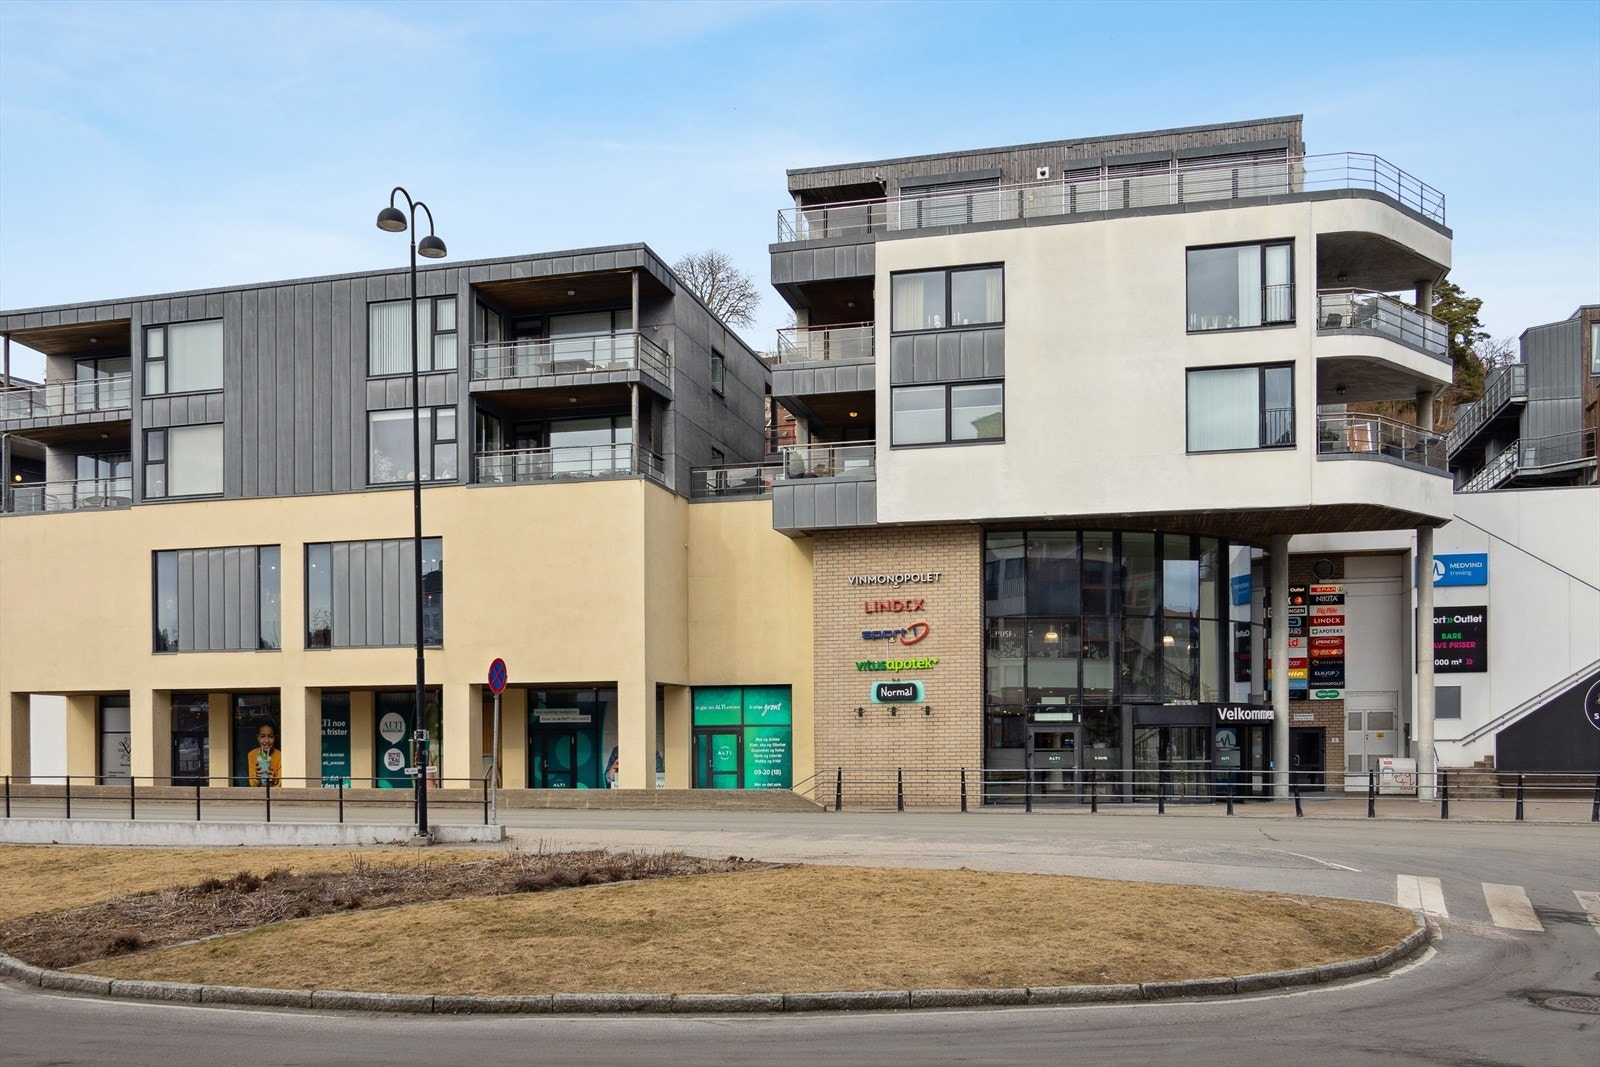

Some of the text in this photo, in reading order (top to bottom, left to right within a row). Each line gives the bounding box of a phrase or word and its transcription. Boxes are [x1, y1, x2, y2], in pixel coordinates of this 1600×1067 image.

[848, 572, 941, 585] VINMONOPOLET
[864, 600, 924, 613] LINDEX
[1454, 615, 1482, 623] Outlet
[862, 628, 907, 640] sport
[856, 658, 933, 672] vitusapotek
[880, 688, 912, 697] Normal
[382, 722, 402, 730] ALTI
[326, 727, 348, 736] frister
